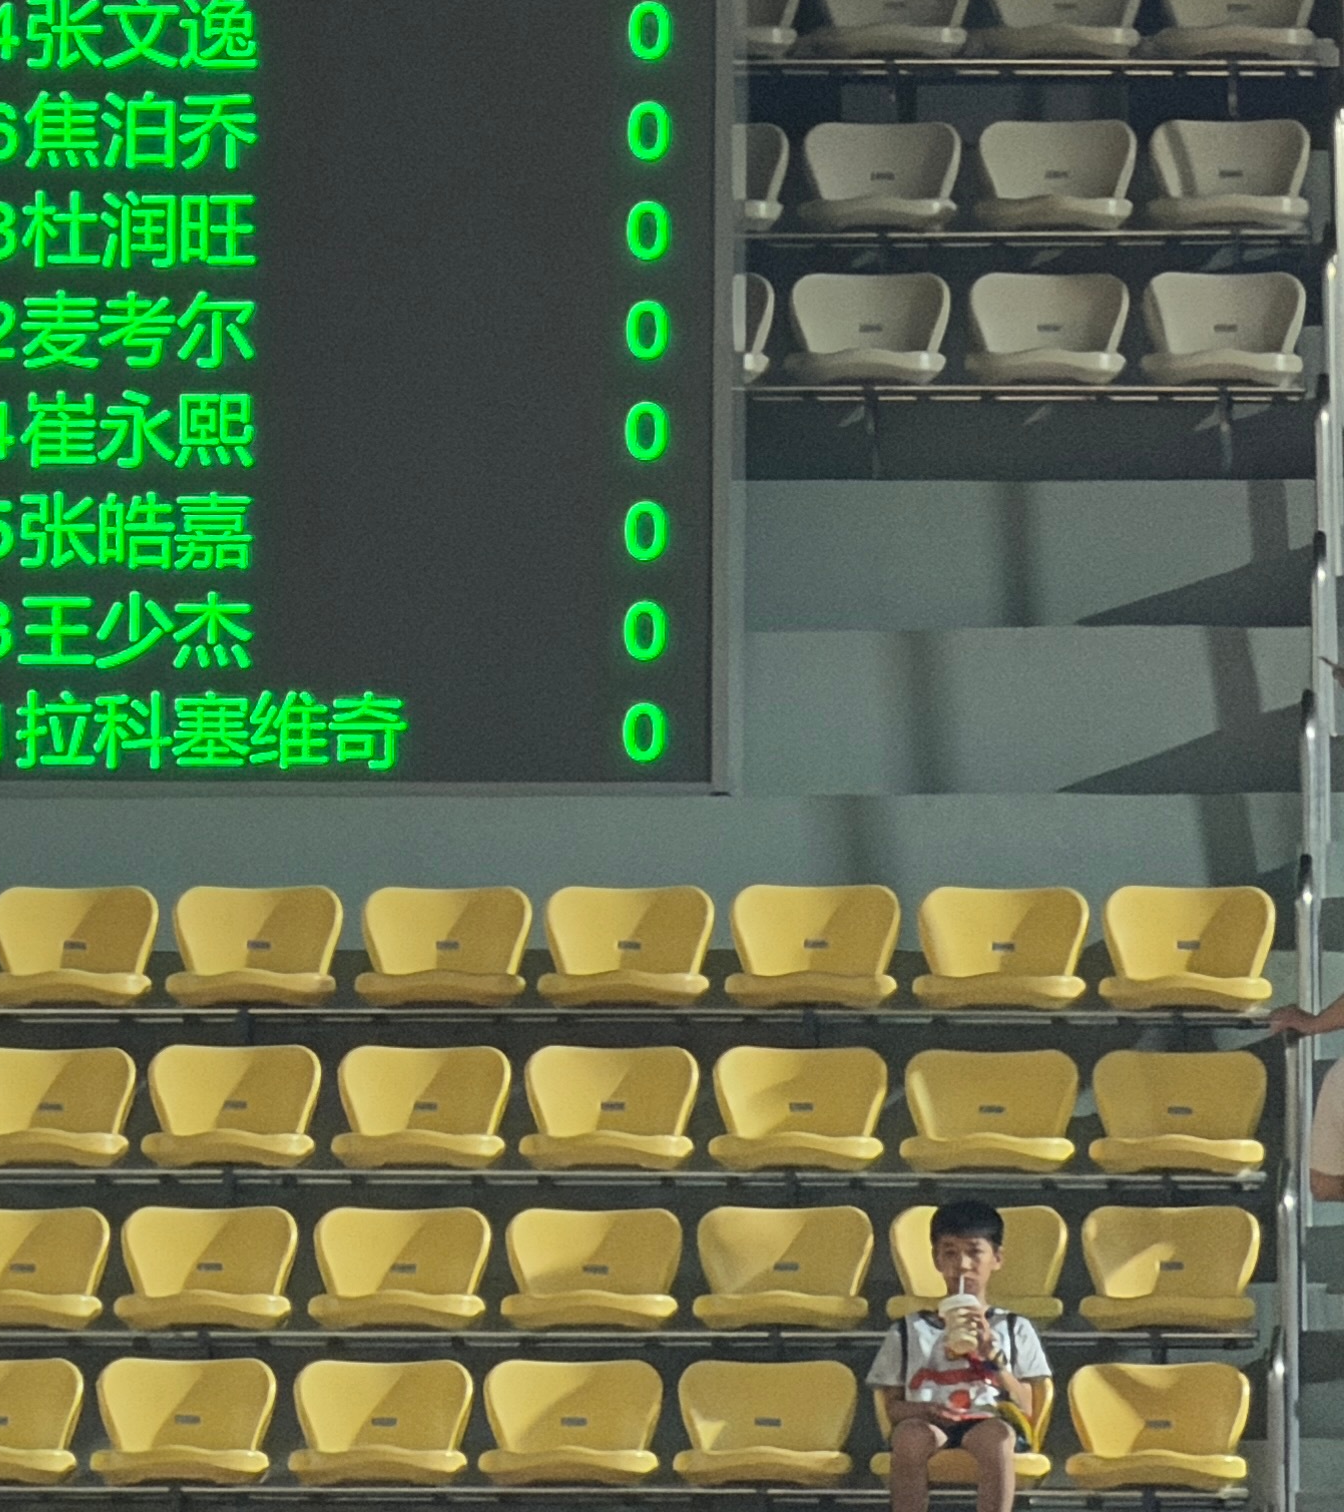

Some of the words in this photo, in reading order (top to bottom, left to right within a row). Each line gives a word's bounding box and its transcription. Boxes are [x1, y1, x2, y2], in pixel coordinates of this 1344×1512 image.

[628, 1, 671, 61] 0
[627, 101, 671, 161] 0
[626, 201, 670, 260] 0
[626, 300, 669, 360] 0
[625, 401, 668, 460] 0
[624, 501, 667, 560] 0
[623, 600, 667, 660] 0
[622, 703, 666, 762] 0
